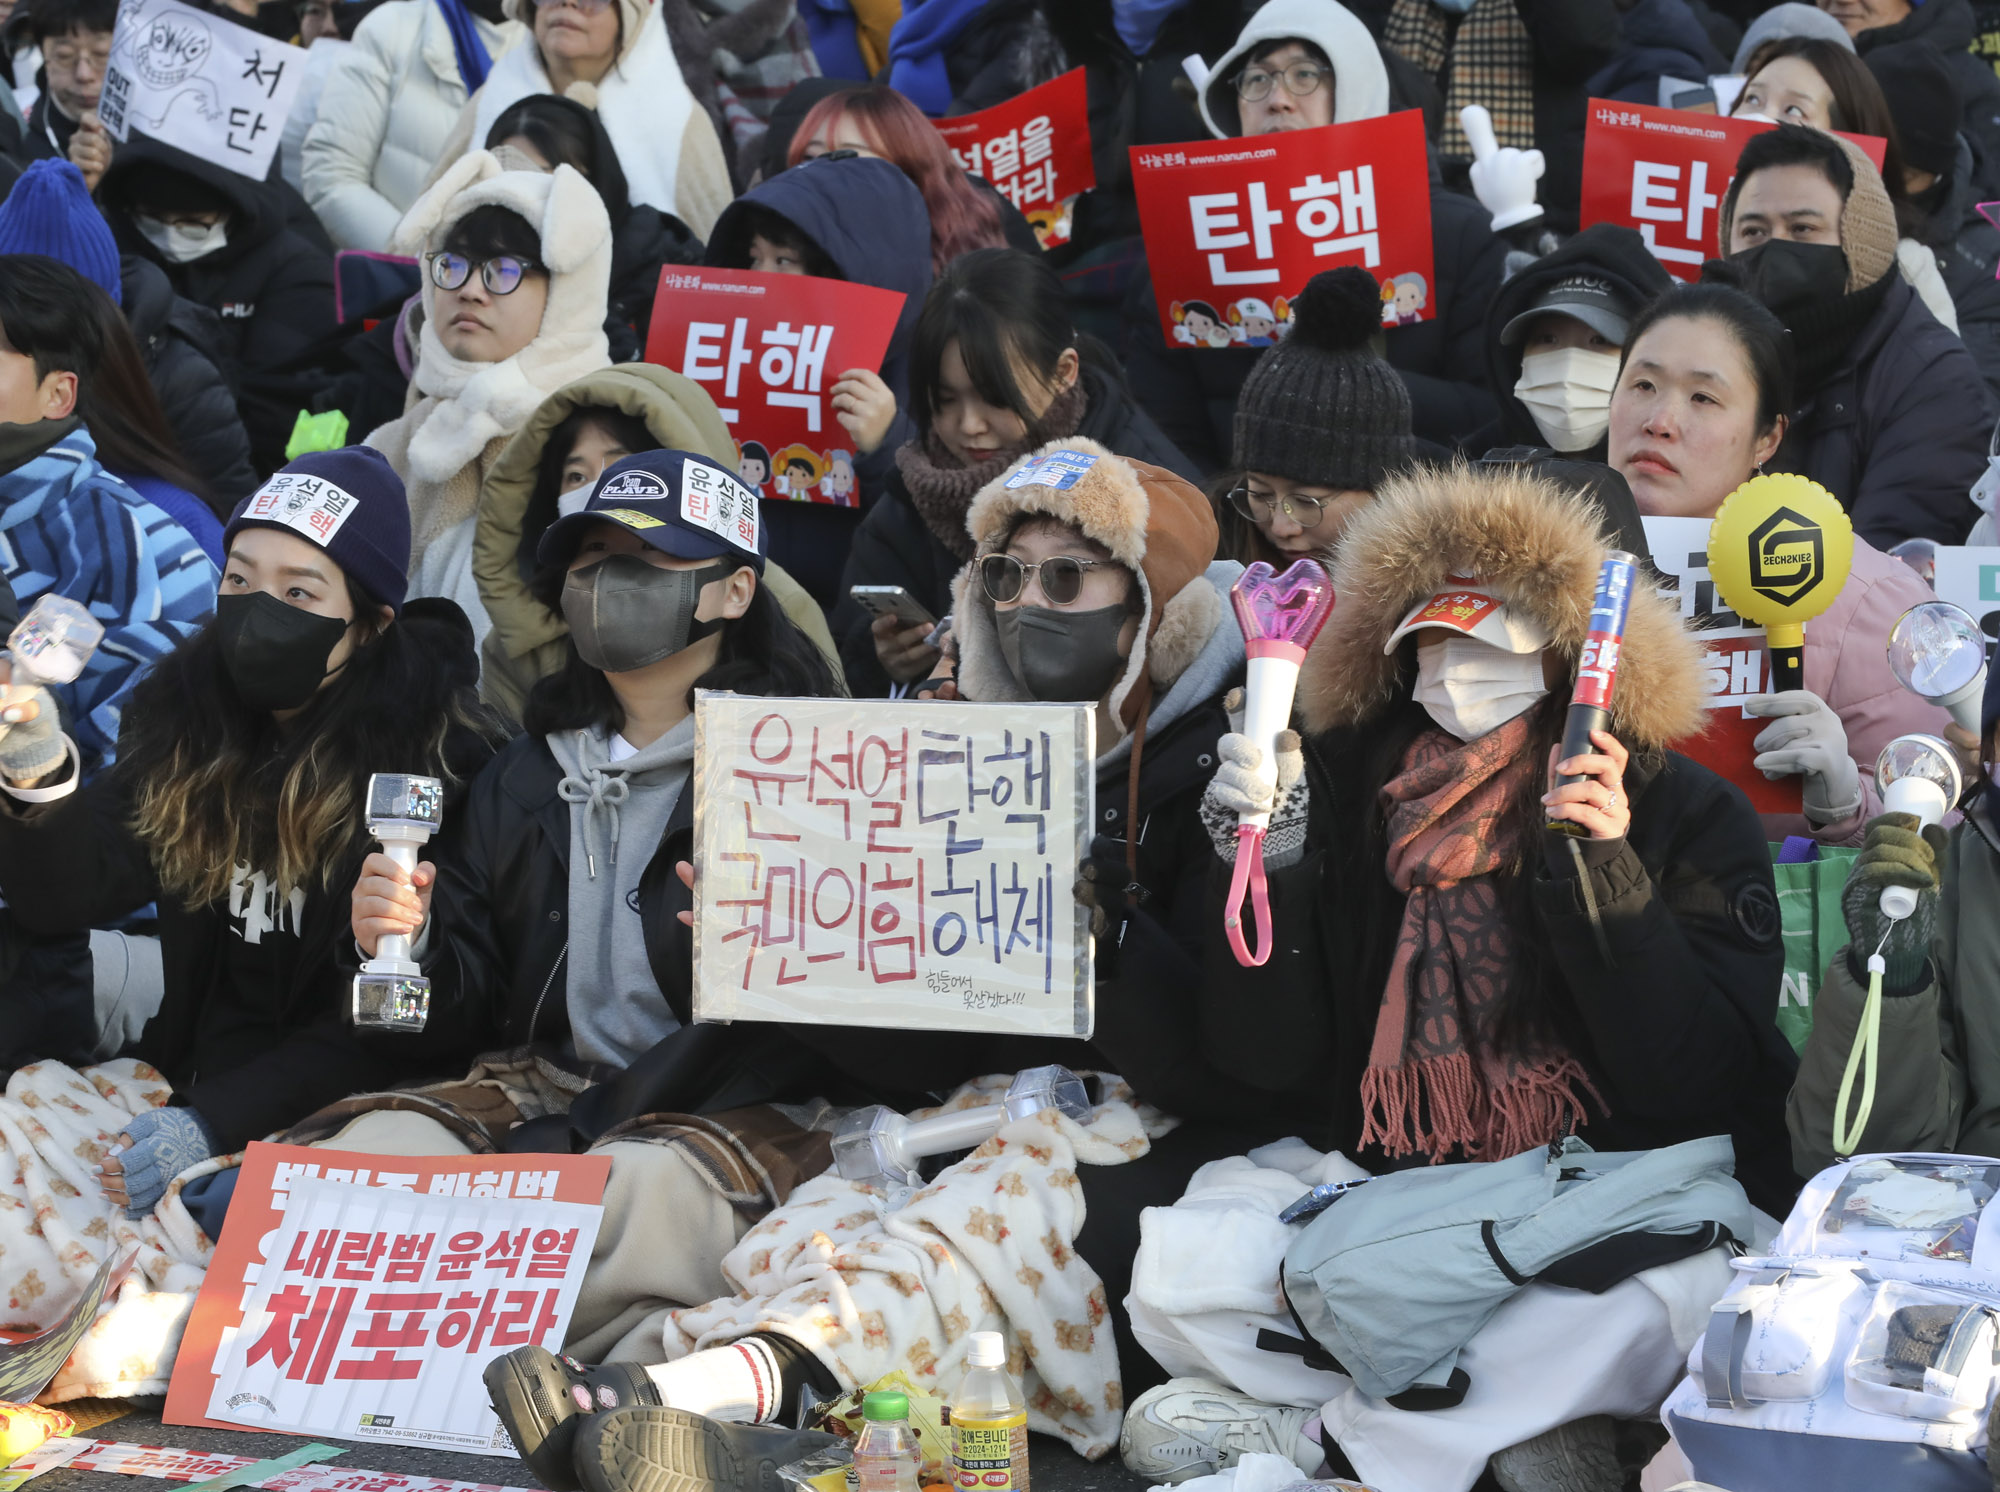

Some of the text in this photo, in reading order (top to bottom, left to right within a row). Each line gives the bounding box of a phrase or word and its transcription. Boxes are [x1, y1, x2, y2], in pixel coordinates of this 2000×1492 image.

[107, 66, 131, 96] OUT
[100, 100, 124, 134] 탄핵
[1596, 109, 1726, 140] 나눔문화 www.nanum.com
[950, 115, 1054, 180] 석열을
[1139, 148, 1276, 168] 나눔문화 www.nanum.com
[1188, 164, 1381, 286] 탄핵
[1631, 160, 1735, 265] 탄
[701, 282, 766, 295] www.nanum.com
[682, 317, 835, 432] 탄핵
[268, 477, 350, 517] 윤석열
[604, 485, 659, 495] PLAVE
[623, 475, 641, 488] Team
[689, 467, 755, 522] 윤석열
[1763, 552, 1812, 566] SECHSKIES
[1699, 649, 1774, 720] 핵
[732, 713, 1051, 856] 윤석열 탄핵
[715, 852, 1052, 994] 국민의힘 해체
[925, 968, 973, 994] 힘들어서
[283, 1227, 580, 1283] 내란범 윤석열
[246, 1284, 559, 1385] 체포하라
[121, 1452, 247, 1476] DANGE
[969, 1444, 1007, 1454] 2024-1214
